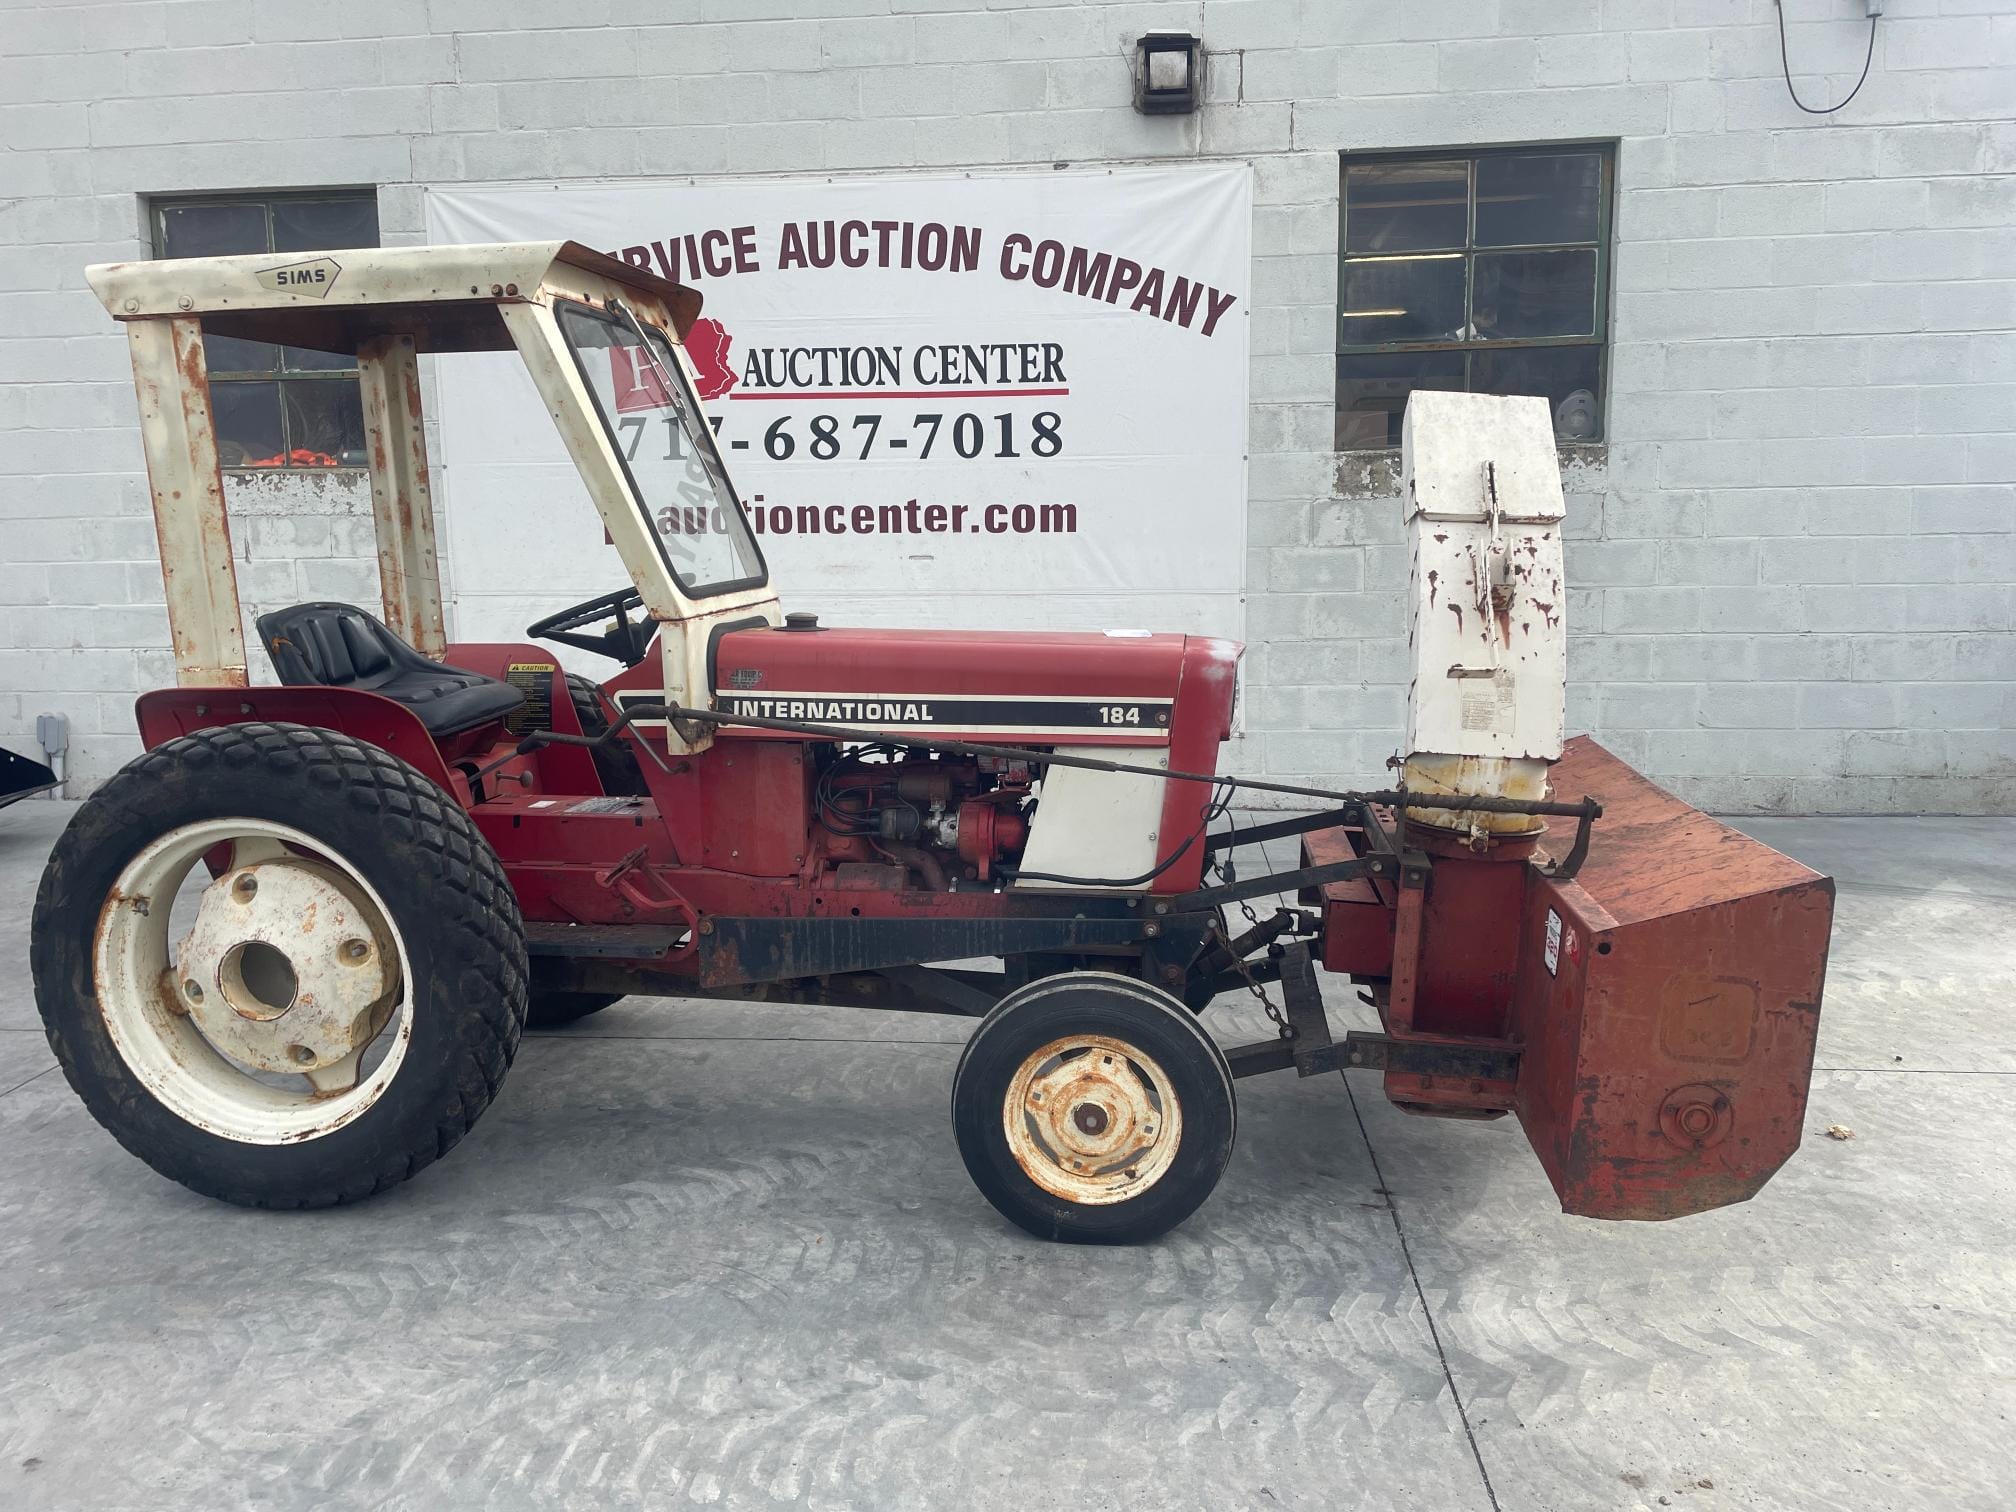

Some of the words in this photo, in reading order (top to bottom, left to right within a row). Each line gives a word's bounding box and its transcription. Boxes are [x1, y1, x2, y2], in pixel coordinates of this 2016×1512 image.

[277, 269, 326, 286] SIMS
[778, 219, 982, 273] AUCTION
[999, 233, 1238, 338] COMPANY
[741, 346, 902, 388] AUCTION
[913, 342, 1067, 386] CENTER
[733, 700, 933, 722] INTERNATIONAL
[1099, 706, 1140, 724] 184
